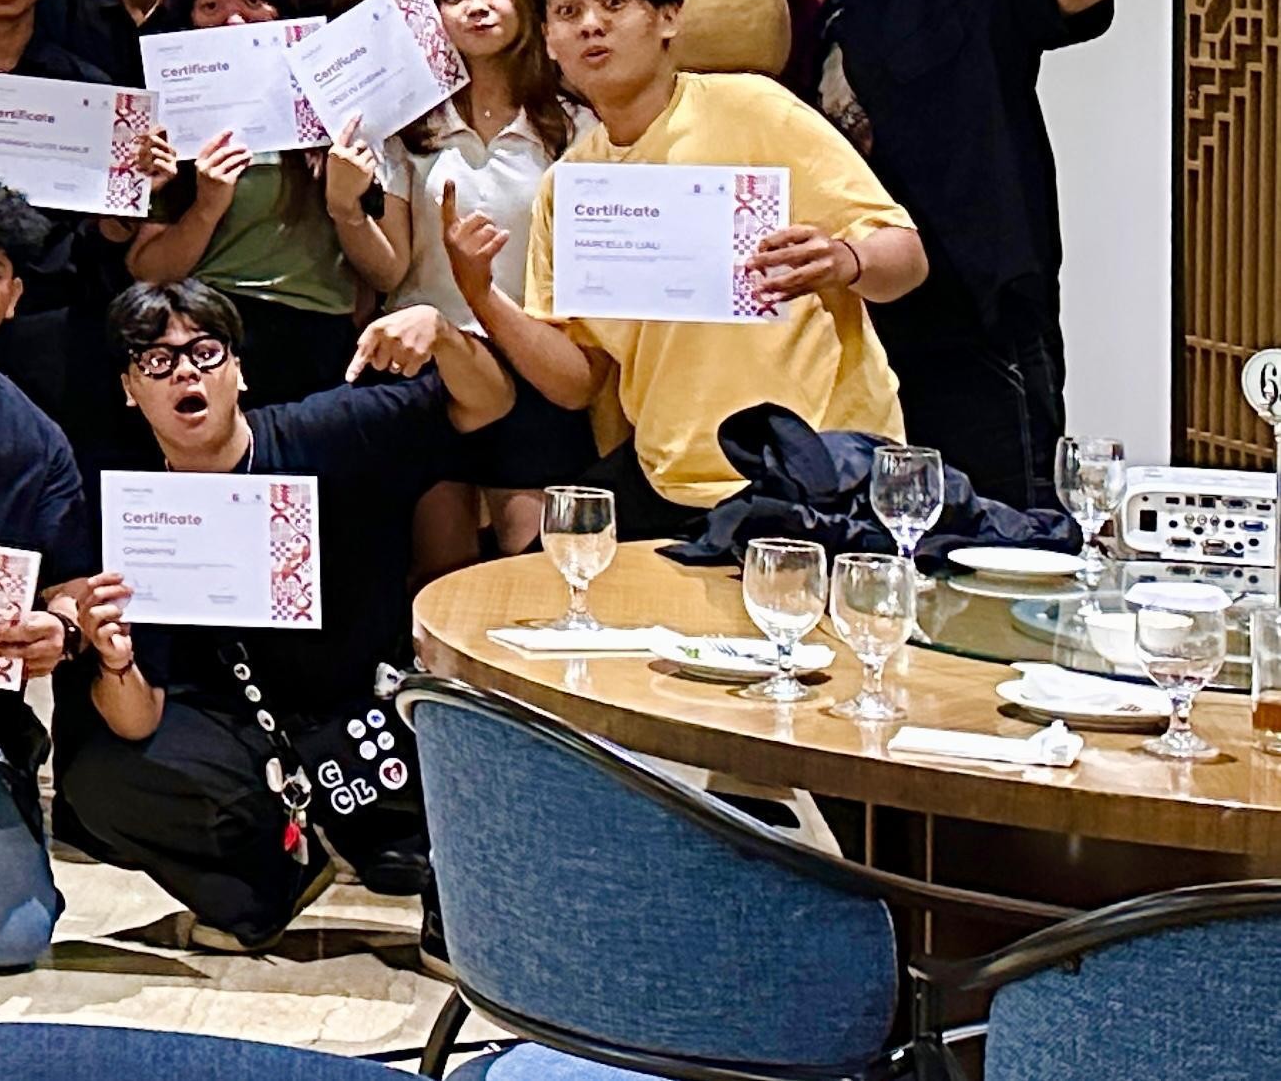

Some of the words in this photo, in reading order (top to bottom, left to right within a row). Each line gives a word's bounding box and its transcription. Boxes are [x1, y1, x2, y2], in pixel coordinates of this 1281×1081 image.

[160, 60, 230, 79] Certificate
[574, 203, 660, 218] Certificate
[1260, 362, 1281, 416] 6
[122, 511, 202, 526] Certificate
